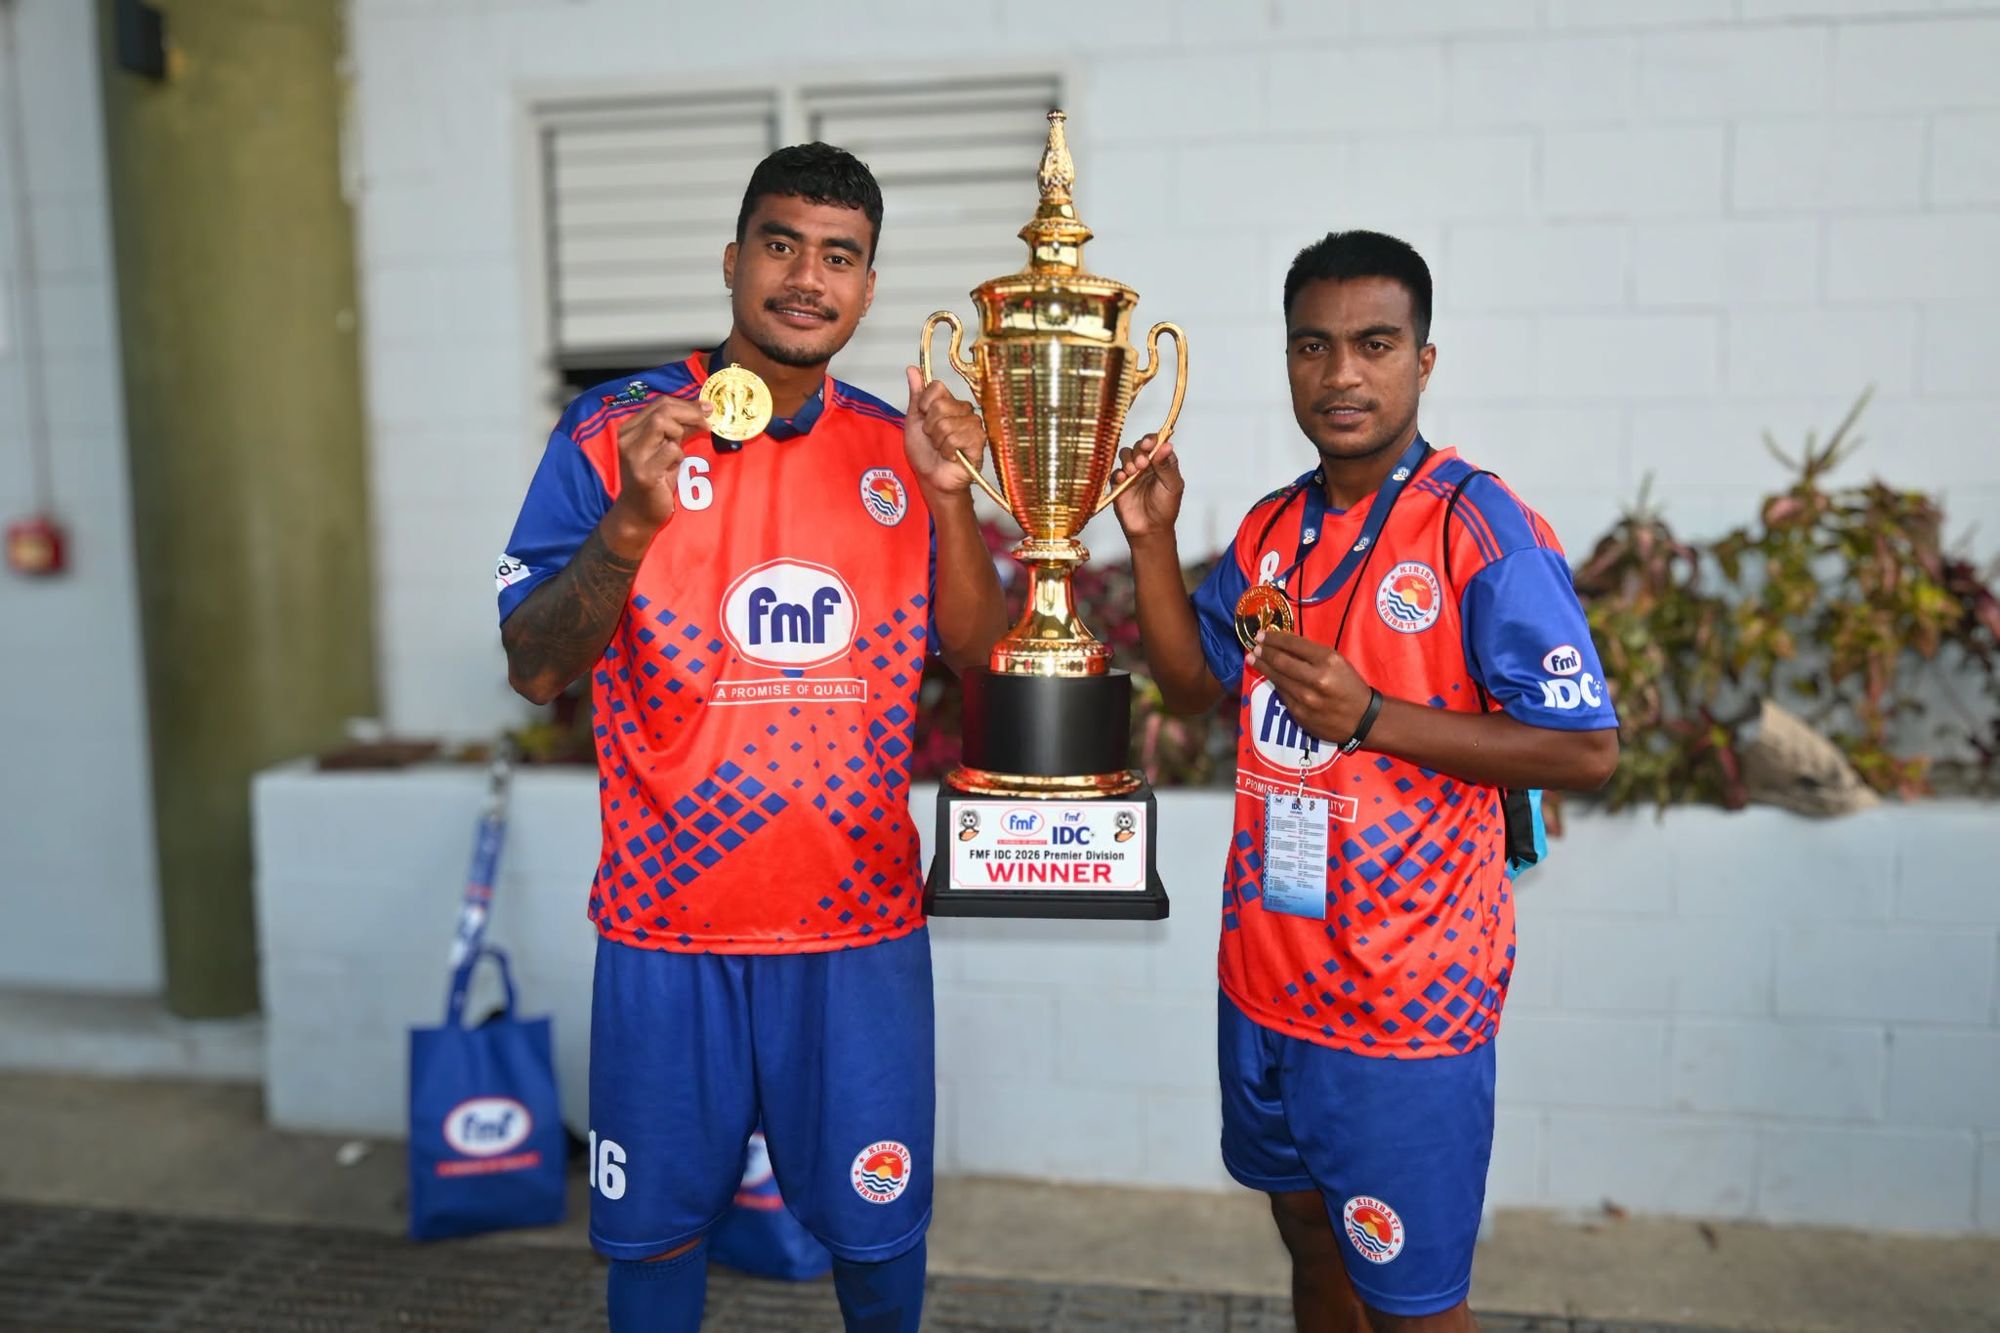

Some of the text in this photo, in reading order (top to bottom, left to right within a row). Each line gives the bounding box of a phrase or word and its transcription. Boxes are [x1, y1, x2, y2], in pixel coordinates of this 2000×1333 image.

[865, 497, 896, 524] KIRIBATI
[1399, 565, 1438, 597] KIRIBATI
[748, 586, 842, 645] fmf
[1379, 599, 1418, 630] KIRIBATI
[716, 687, 727, 699] A
[731, 684, 791, 698] PROMISE
[797, 684, 809, 695] OF
[1537, 672, 1601, 709] IDC
[1259, 689, 1320, 753] fm
[1009, 814, 1037, 830] fmf
[1064, 812, 1081, 822] fmf
[1052, 826, 1091, 845] IDC
[969, 849, 1125, 861] FMF IDC 2026 Premier Division
[985, 862, 1112, 883] WINNER
[588, 1129, 627, 1200] 16
[868, 1143, 909, 1162] KIRIBATI
[855, 1180, 897, 1202] KIRIBATI
[1355, 1198, 1401, 1230] KIRIBATI
[1347, 1227, 1383, 1261] KIRIBATI
